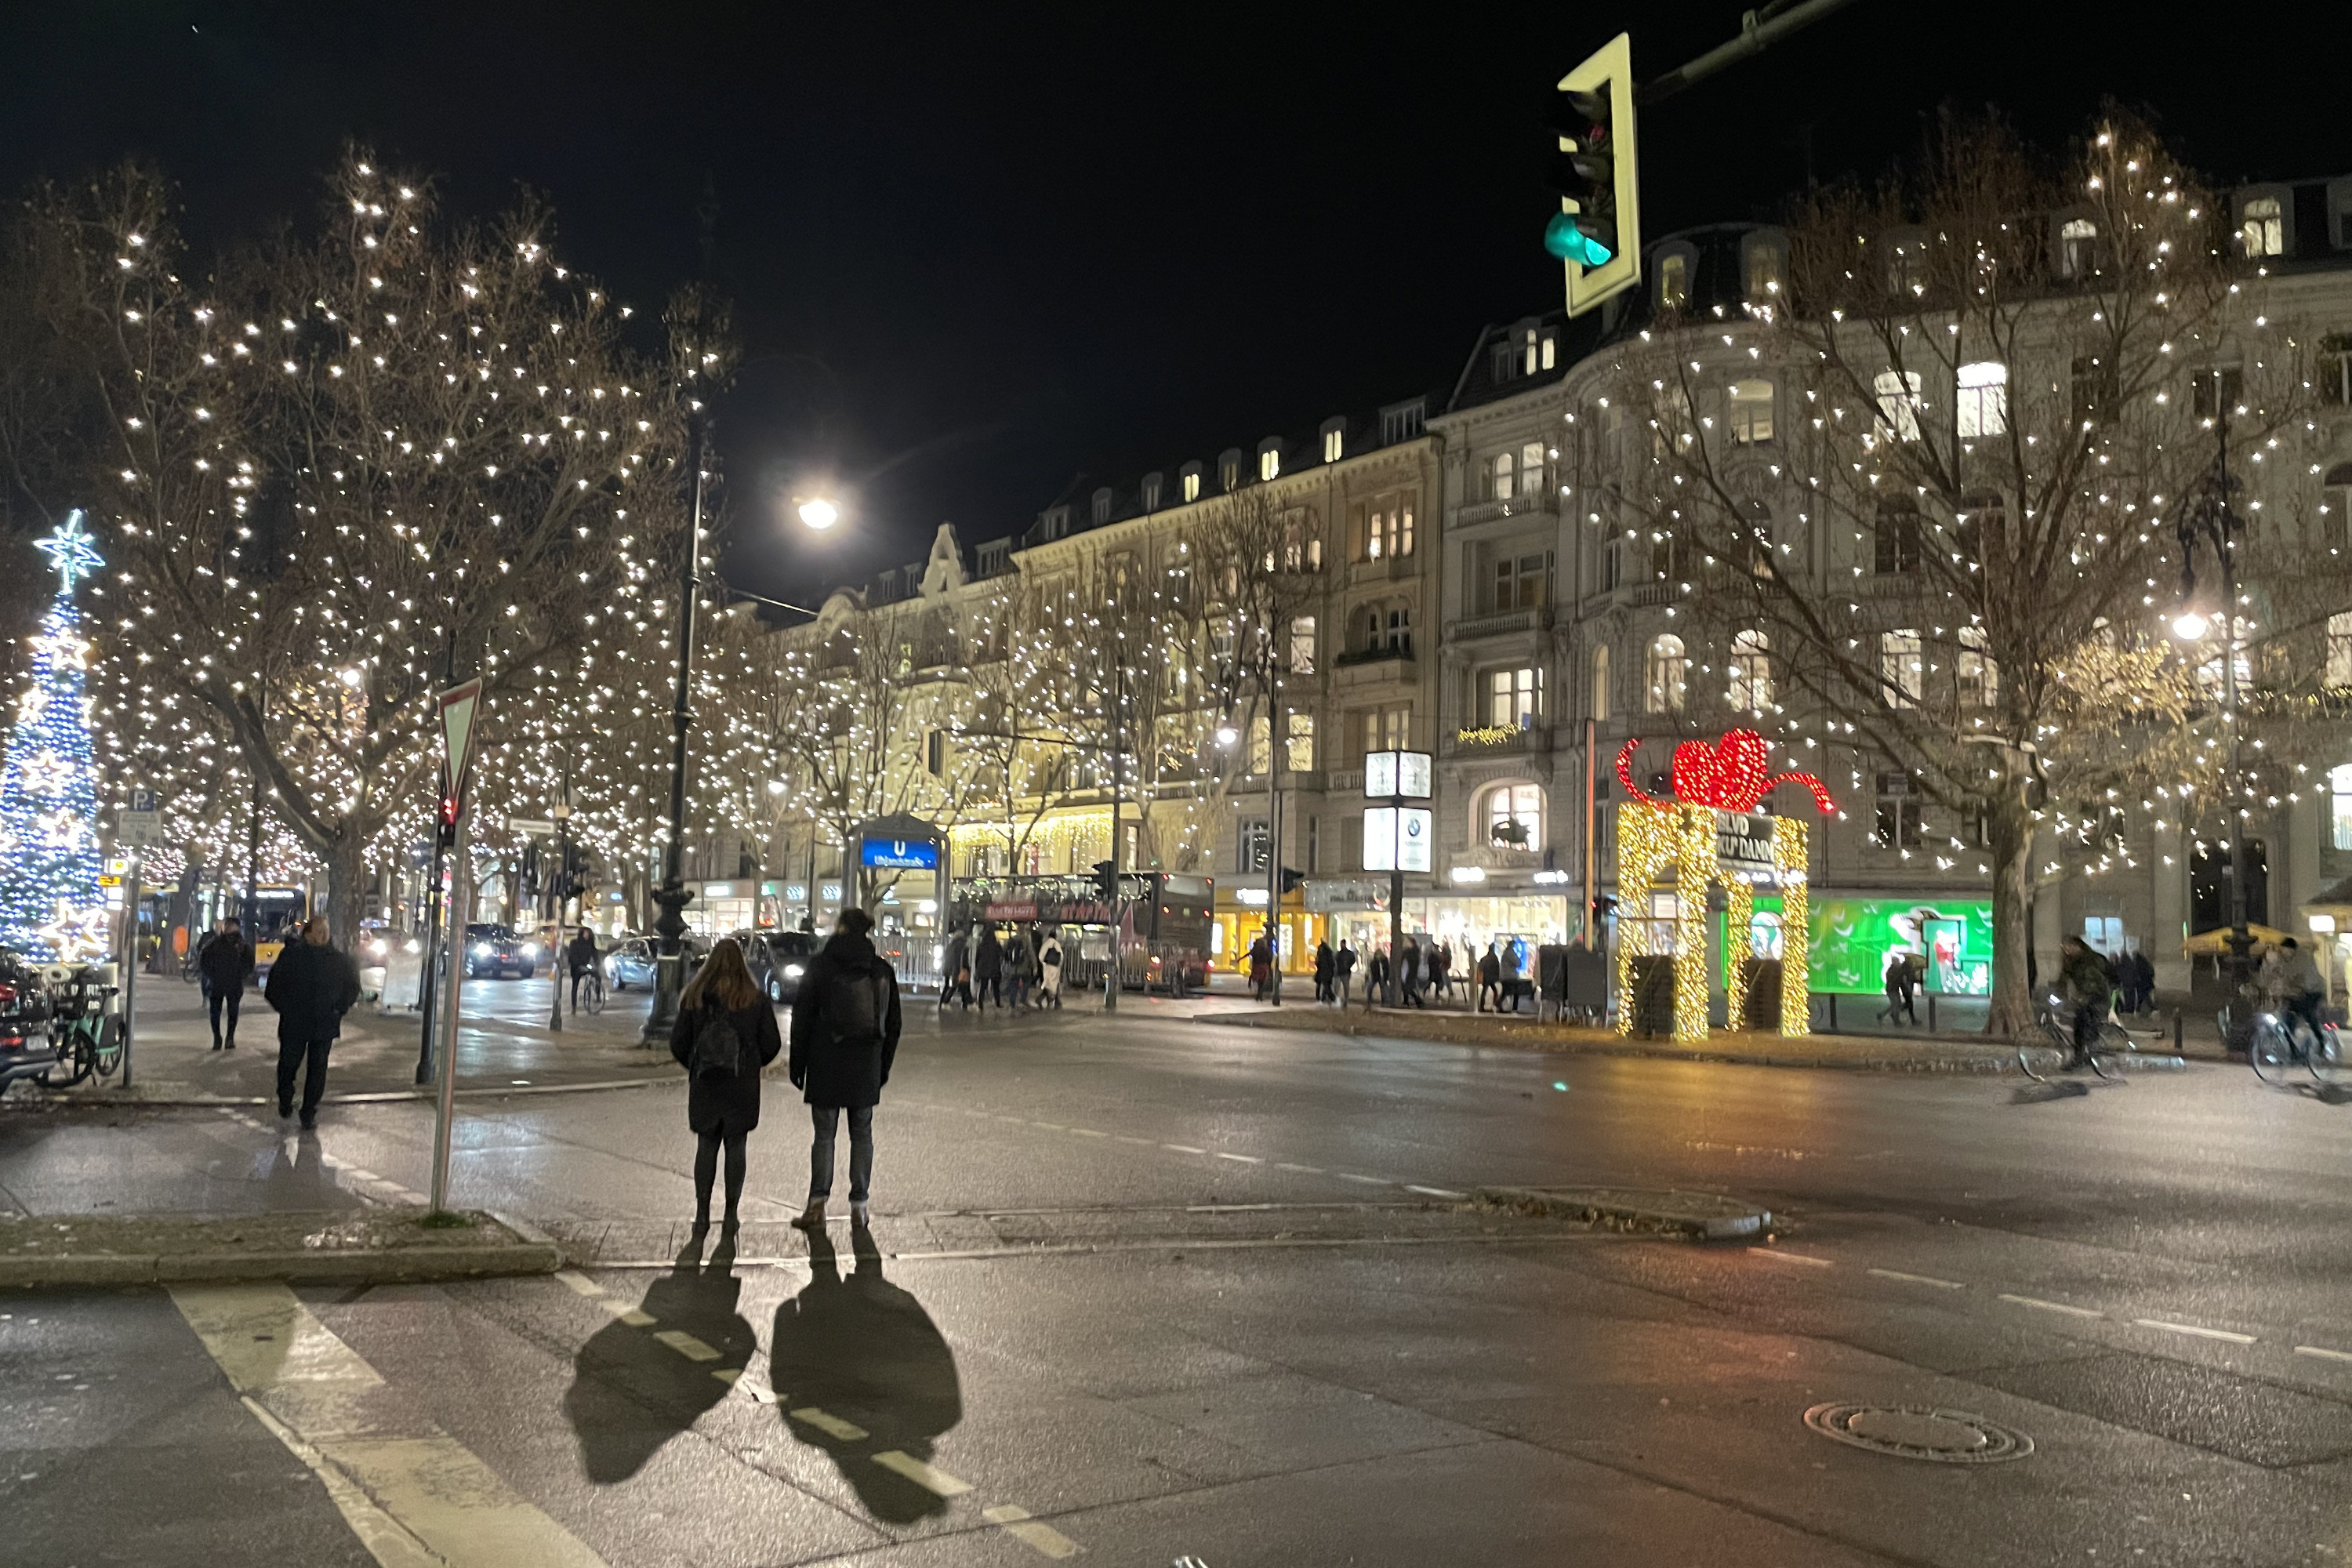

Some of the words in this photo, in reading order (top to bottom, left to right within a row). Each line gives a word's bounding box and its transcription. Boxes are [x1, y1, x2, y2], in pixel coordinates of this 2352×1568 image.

[133, 790, 149, 811] P
[1717, 812, 1750, 837] BLVD
[894, 840, 906, 857] U
